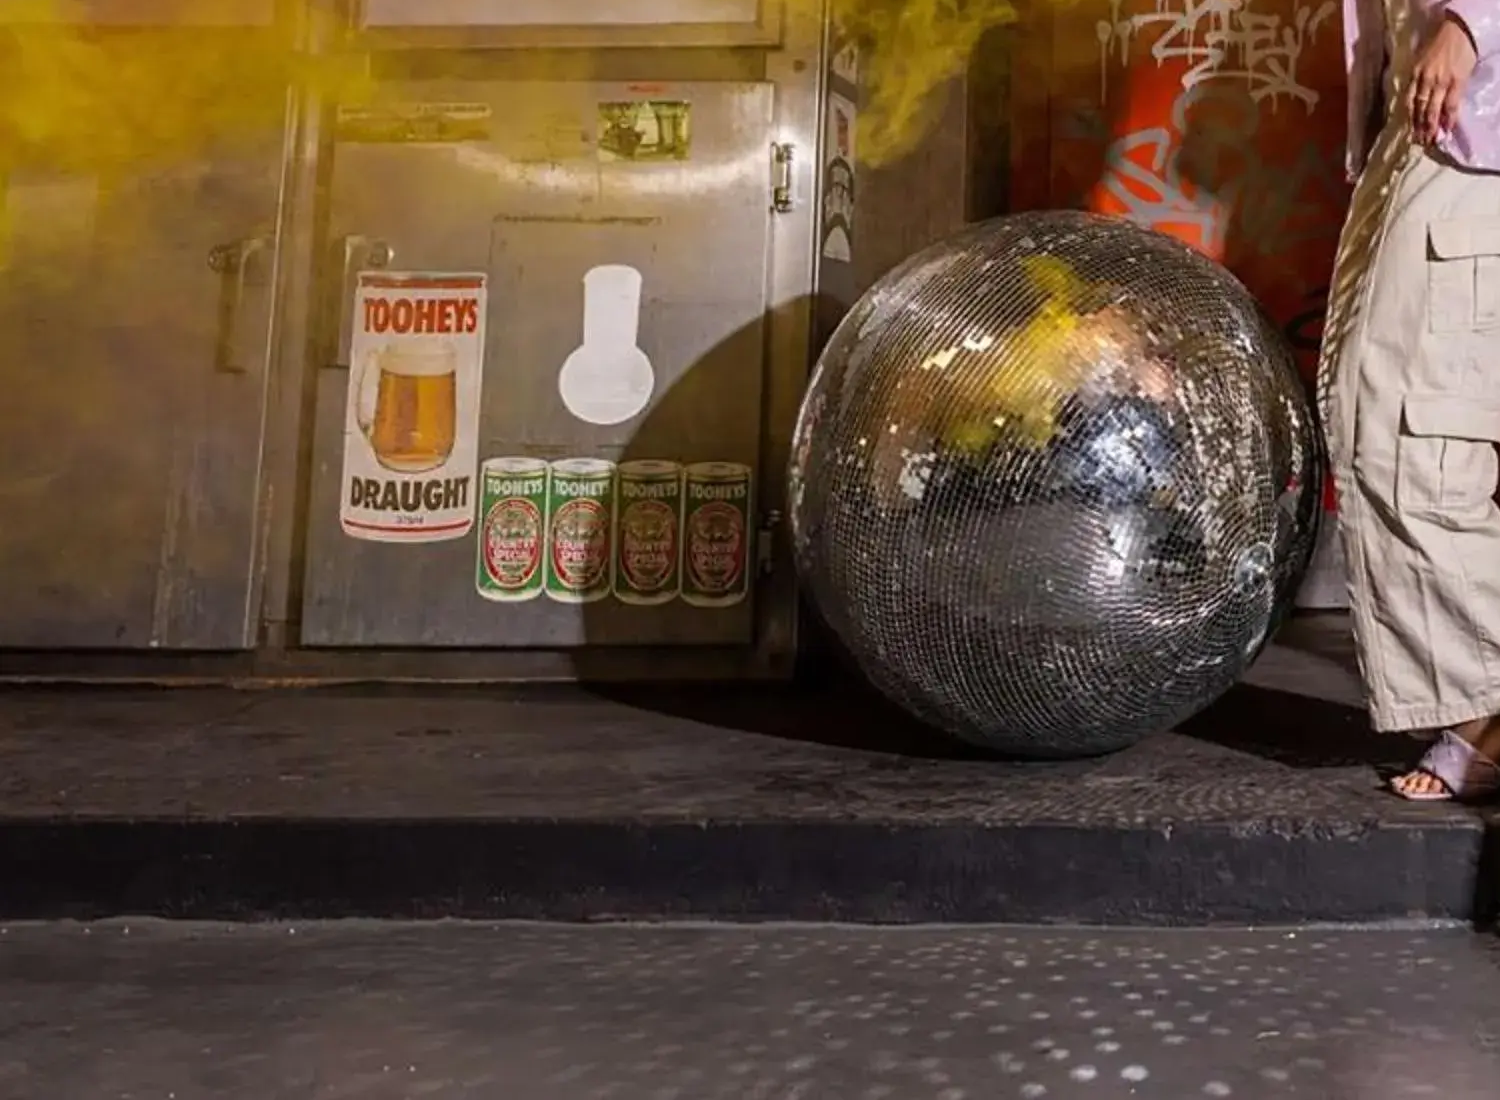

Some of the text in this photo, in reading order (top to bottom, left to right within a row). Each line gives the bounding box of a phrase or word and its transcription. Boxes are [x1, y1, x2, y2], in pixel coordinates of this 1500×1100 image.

[363, 297, 478, 334] TOOHEYS
[350, 475, 470, 512] DRAUGHT
[486, 479, 543, 496] TOOHEYS
[621, 481, 679, 499] TOOHEYS
[688, 483, 747, 500] TOOHEYS
